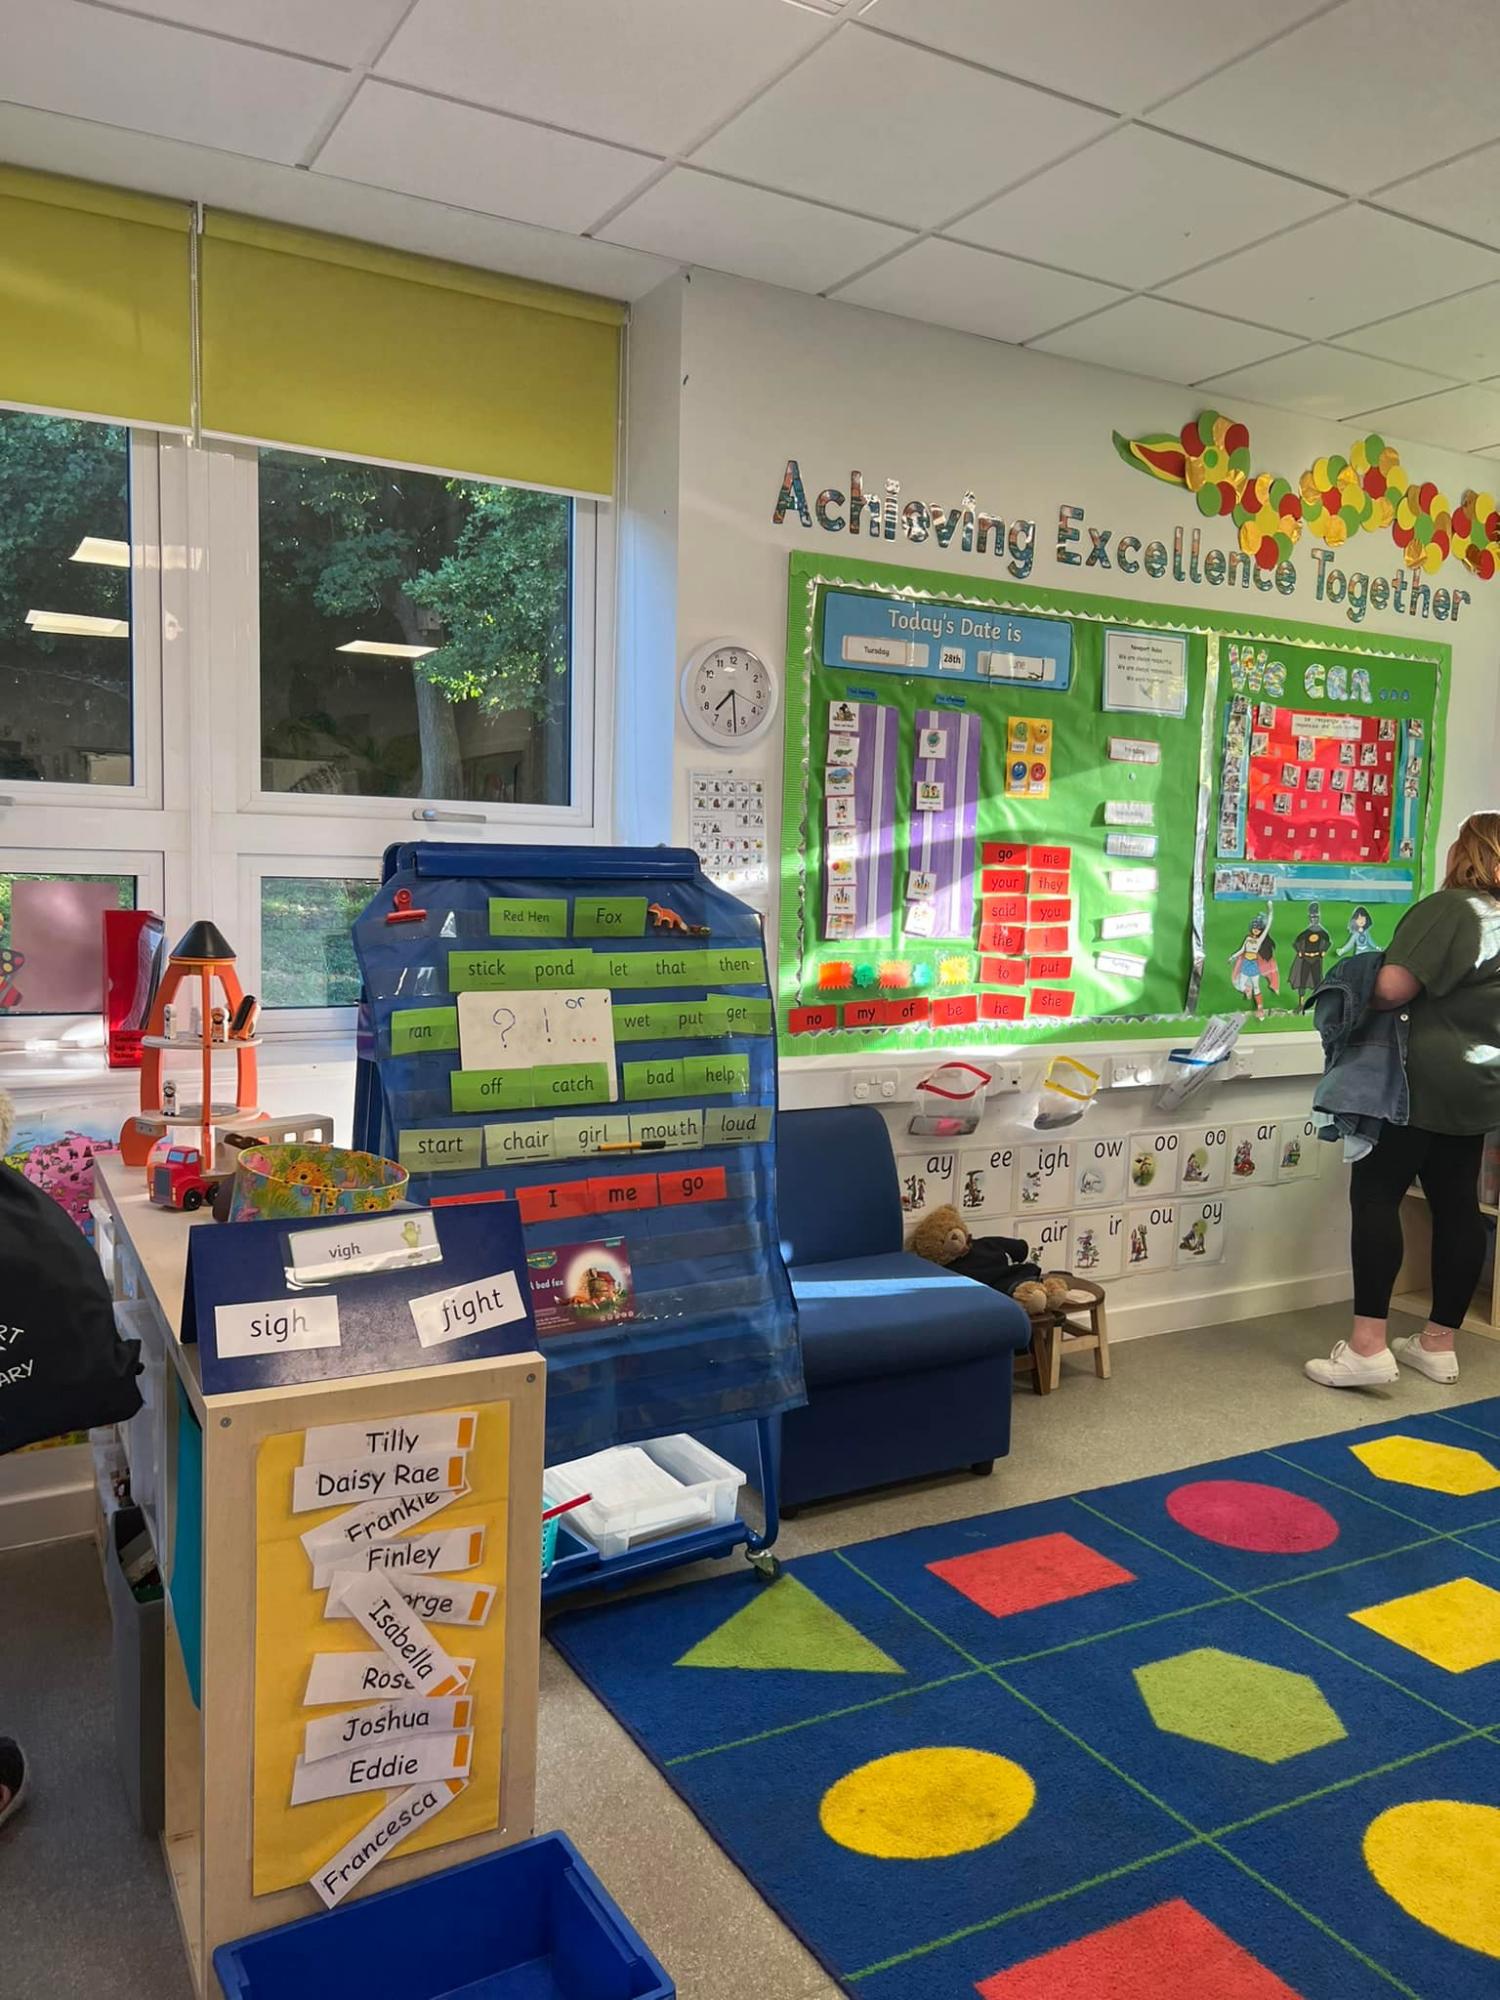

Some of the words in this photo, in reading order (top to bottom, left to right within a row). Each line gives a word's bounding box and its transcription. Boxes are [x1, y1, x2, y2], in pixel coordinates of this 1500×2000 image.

[773, 460, 1035, 579] Achieving
[1056, 504, 1297, 595] Excellence
[1311, 547, 1471, 623] Together
[888, 609, 955, 638] Today's
[961, 618, 1002, 640] Date
[1007, 622, 1022, 643] is
[716, 659, 724, 668] 11
[729, 656, 738, 665] 12
[944, 653, 961, 665] 28th
[753, 674, 759, 683] 2
[1228, 643, 1287, 698] We
[700, 684, 706, 694] 9
[756, 690, 762, 699] 3
[704, 701, 710, 710] 8
[751, 706, 756, 714] 4
[714, 713, 720, 722] 7
[726, 720, 732, 729] 6
[740, 716, 746, 725] 5
[998, 850, 1014, 862] go
[1043, 853, 1060, 865] me
[991, 876, 1019, 889] your
[1039, 878, 1063, 892] they
[503, 910, 524, 923] Red
[528, 911, 550, 923] Hen
[596, 907, 622, 925] Fox
[992, 904, 1016, 917] said
[1040, 907, 1061, 921] you
[992, 933, 1013, 947] the
[468, 959, 506, 976] stick
[534, 959, 575, 979] pond
[609, 960, 628, 976] let
[655, 959, 687, 975] that
[719, 957, 750, 973] then
[998, 965, 1010, 980] to
[1040, 961, 1060, 977] put
[624, 1013, 650, 1028] wet
[678, 1012, 703, 1030] put
[726, 1007, 747, 1025] get
[807, 1014, 822, 1025] no
[857, 1008, 875, 1021] my
[902, 1003, 916, 1017] of
[947, 1003, 963, 1016] be
[994, 1001, 1009, 1015] he
[1041, 995, 1061, 1007] she
[409, 1025, 432, 1039] ran
[480, 1077, 503, 1096] off
[552, 1076, 594, 1093] catch
[646, 1068, 675, 1086] bad
[705, 1067, 735, 1085] help
[418, 1136, 463, 1154] start
[503, 1131, 549, 1150] chair
[578, 1126, 609, 1148] girl
[640, 1119, 698, 1139] mouth
[720, 1114, 757, 1132] loud
[1205, 1130, 1226, 1146] oo
[1257, 1124, 1276, 1140] ar
[1094, 1140, 1123, 1159] ow
[1155, 1134, 1178, 1152] oo
[926, 1153, 953, 1180] ay
[989, 1149, 1013, 1168] ee
[1038, 1145, 1070, 1177] igh
[547, 1190, 558, 1208] I
[608, 1187, 637, 1202] me
[682, 1175, 704, 1196] go
[1150, 1207, 1173, 1226] ou
[1202, 1203, 1222, 1225] oy
[1041, 1221, 1068, 1244] air
[1109, 1215, 1122, 1236] ir
[329, 1243, 361, 1260] vigh
[442, 1288, 504, 1331] fight
[250, 1309, 309, 1343] sigh
[366, 1429, 419, 1454] Tilly
[318, 1469, 386, 1497] Daisy
[395, 1464, 440, 1485] Rae
[347, 1492, 440, 1543] Frankie
[368, 1544, 441, 1571] Finley
[369, 1599, 433, 1680] Isabella
[343, 1708, 429, 1742] Joshua
[349, 1754, 418, 1784] Eddie
[322, 1791, 438, 1896] Francesca
